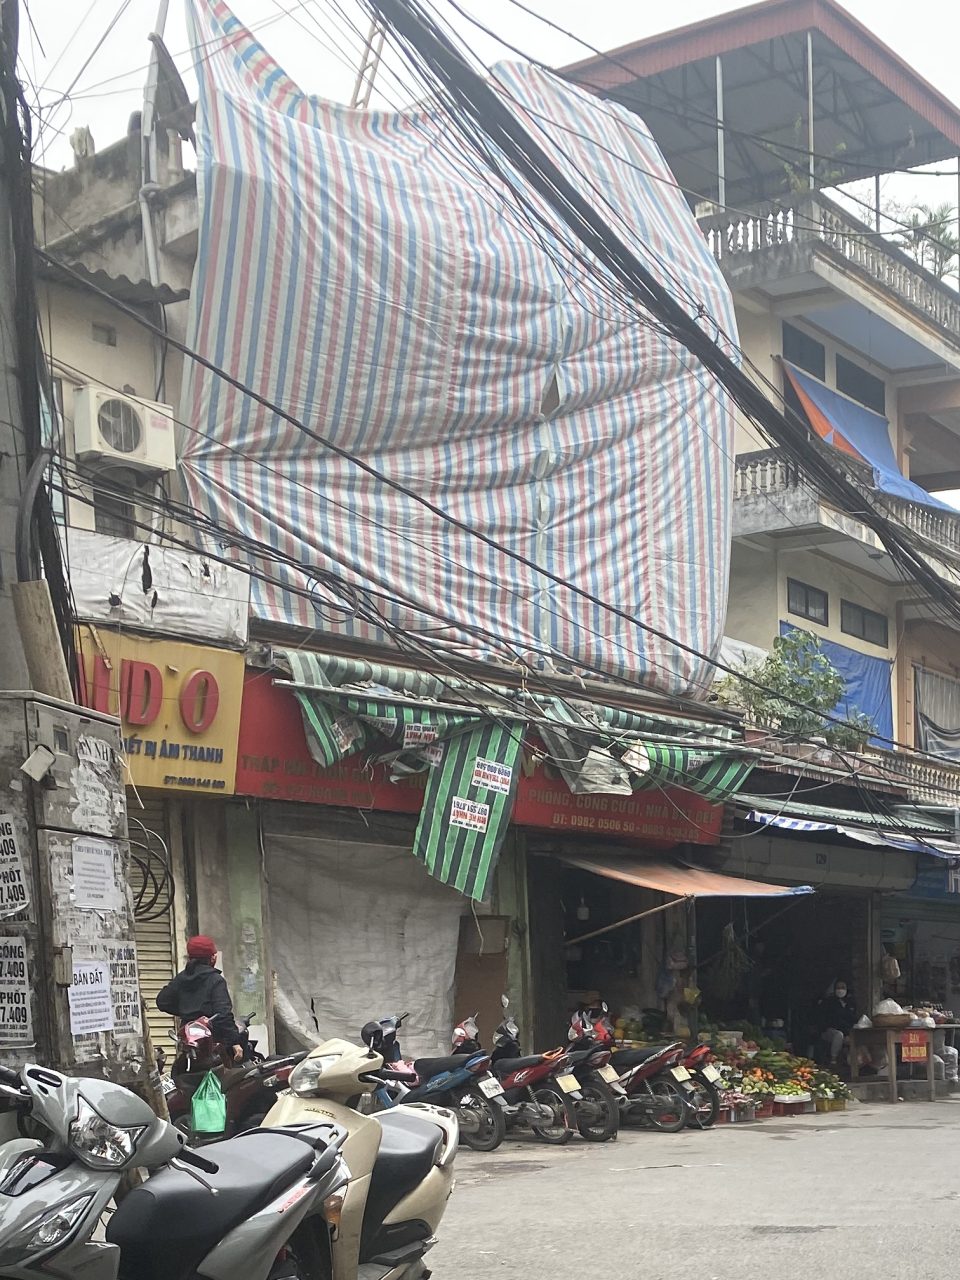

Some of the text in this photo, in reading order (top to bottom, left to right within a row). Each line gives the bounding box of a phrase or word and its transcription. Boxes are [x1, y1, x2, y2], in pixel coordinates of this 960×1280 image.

[182, 744, 223, 764] THANH
[0, 866, 21, 884] HỐT
[73, 966, 103, 986] BÁN ĐẤT
